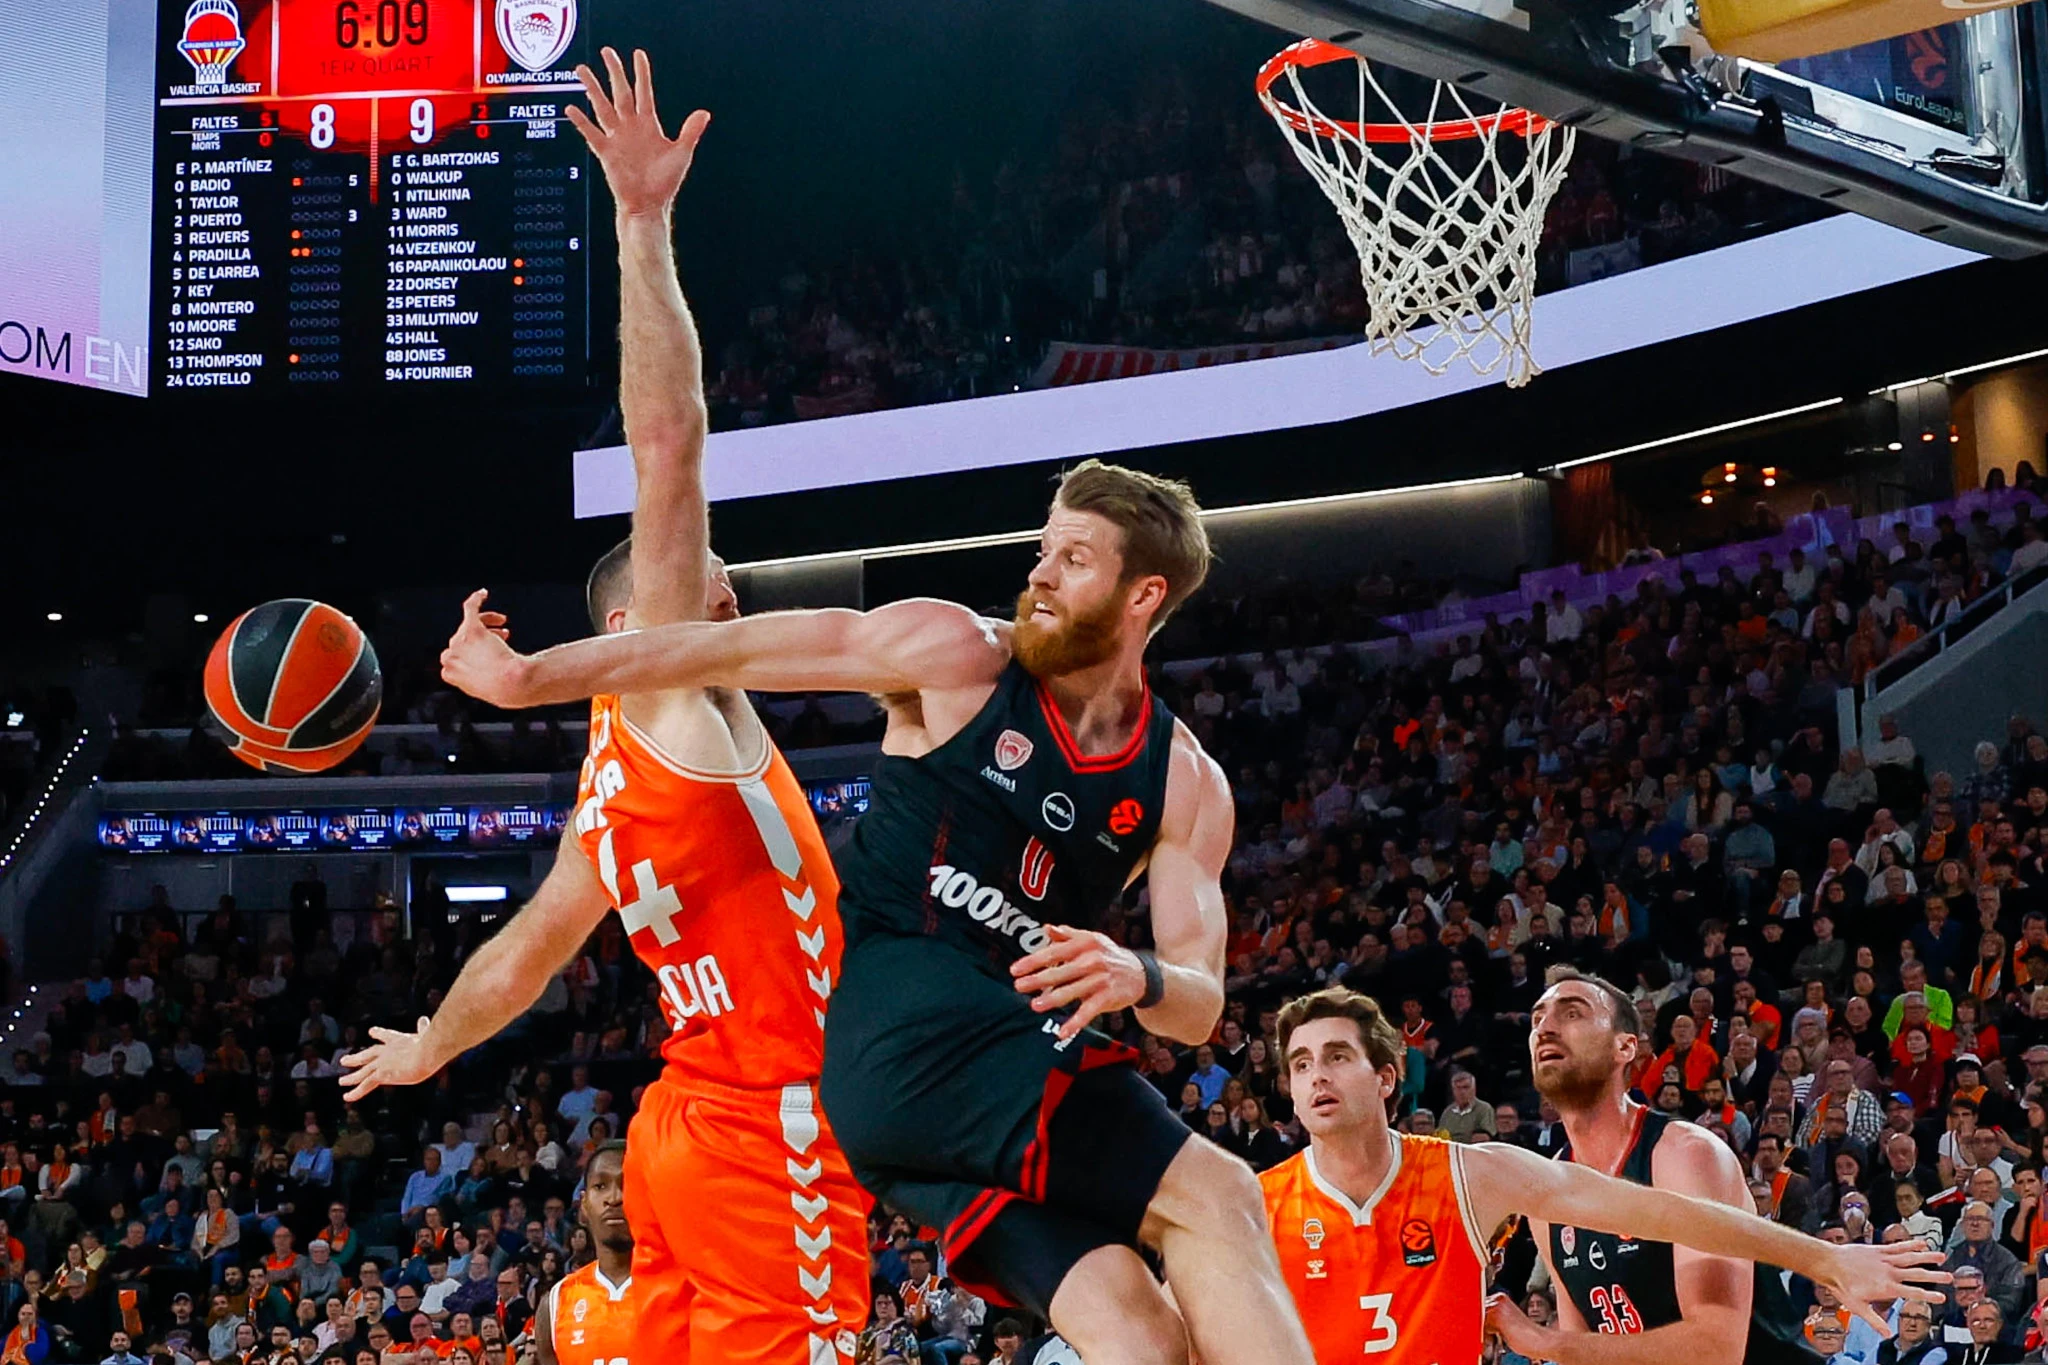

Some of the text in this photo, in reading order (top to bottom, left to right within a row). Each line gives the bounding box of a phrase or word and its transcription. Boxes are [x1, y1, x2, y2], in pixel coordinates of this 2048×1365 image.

[336, 0, 429, 50] 6:09
[320, 56, 435, 77] 1ER QUART
[485, 71, 552, 85] OLYMPIACOS
[169, 82, 261, 96] VALENCIA BASKET
[509, 104, 557, 119] FALTES
[1895, 85, 1965, 124] EuroLeague
[192, 116, 239, 130] FALTES
[310, 103, 335, 149] 8
[409, 98, 435, 144] 9
[528, 120, 556, 130] TEMPS
[191, 132, 220, 142] TEMPS
[526, 129, 556, 139] MORTS
[191, 141, 221, 151] MORTS
[176, 158, 273, 174] E P. MARTÍNEZ
[392, 152, 500, 167] E G. BARTZOKAS
[348, 174, 358, 187] 5
[391, 170, 463, 186] 0 WALKUP
[569, 167, 579, 180] 3
[175, 179, 231, 193] 0 BADIO
[176, 196, 239, 210] 1 TAYLOR
[392, 189, 471, 203] 1 NTILIKINA
[174, 213, 242, 228] 2 PUERTO
[348, 209, 358, 222] 3
[391, 206, 447, 220] 3 WARD
[173, 230, 250, 245] 3 REUVERS
[388, 224, 459, 238] 11 MORRIS
[388, 241, 476, 256] 14 VEZENKOV
[569, 238, 579, 250] 6
[173, 248, 251, 262] 4 PRADILLA
[173, 265, 260, 280] 5 DE LARREA
[388, 258, 507, 274] 16 PAPANIKOLAOU
[172, 284, 214, 298] 7 KEY
[386, 276, 459, 291] 22 DORSEY
[172, 301, 255, 316] 8 MONTERO
[386, 295, 456, 310] 25 PETERS
[169, 319, 237, 334] 10 MOORE
[386, 312, 479, 327] 33 MILUTINOV
[168, 337, 222, 351] 12 SAKO
[386, 331, 439, 345] 45 HALL
[85, 335, 148, 388] EN
[167, 354, 263, 369] 13 THOMPSON
[386, 349, 446, 363] 88 JONES
[166, 371, 251, 387] 24 COSTELLO
[385, 365, 473, 381] 94 FOURNIER
[1589, 1283, 1645, 1336] 33
[1359, 1292, 1399, 1355] 3
